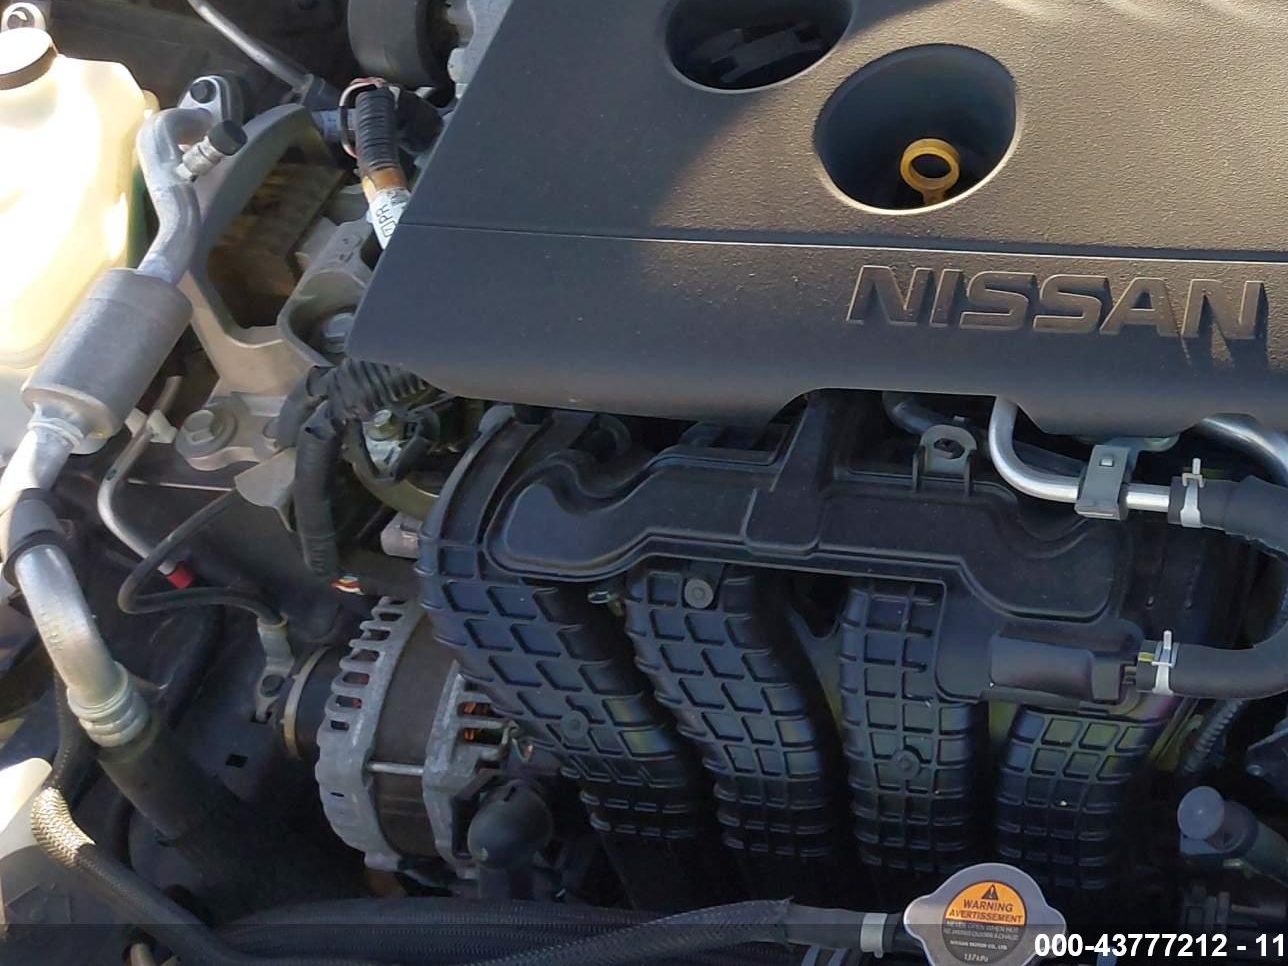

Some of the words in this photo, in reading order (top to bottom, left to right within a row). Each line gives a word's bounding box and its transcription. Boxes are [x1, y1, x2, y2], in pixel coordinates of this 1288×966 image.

[846, 265, 1264, 340] NISSAN
[963, 899, 1013, 912] WARNING
[948, 909, 1023, 922] AVERTISSEMENT
